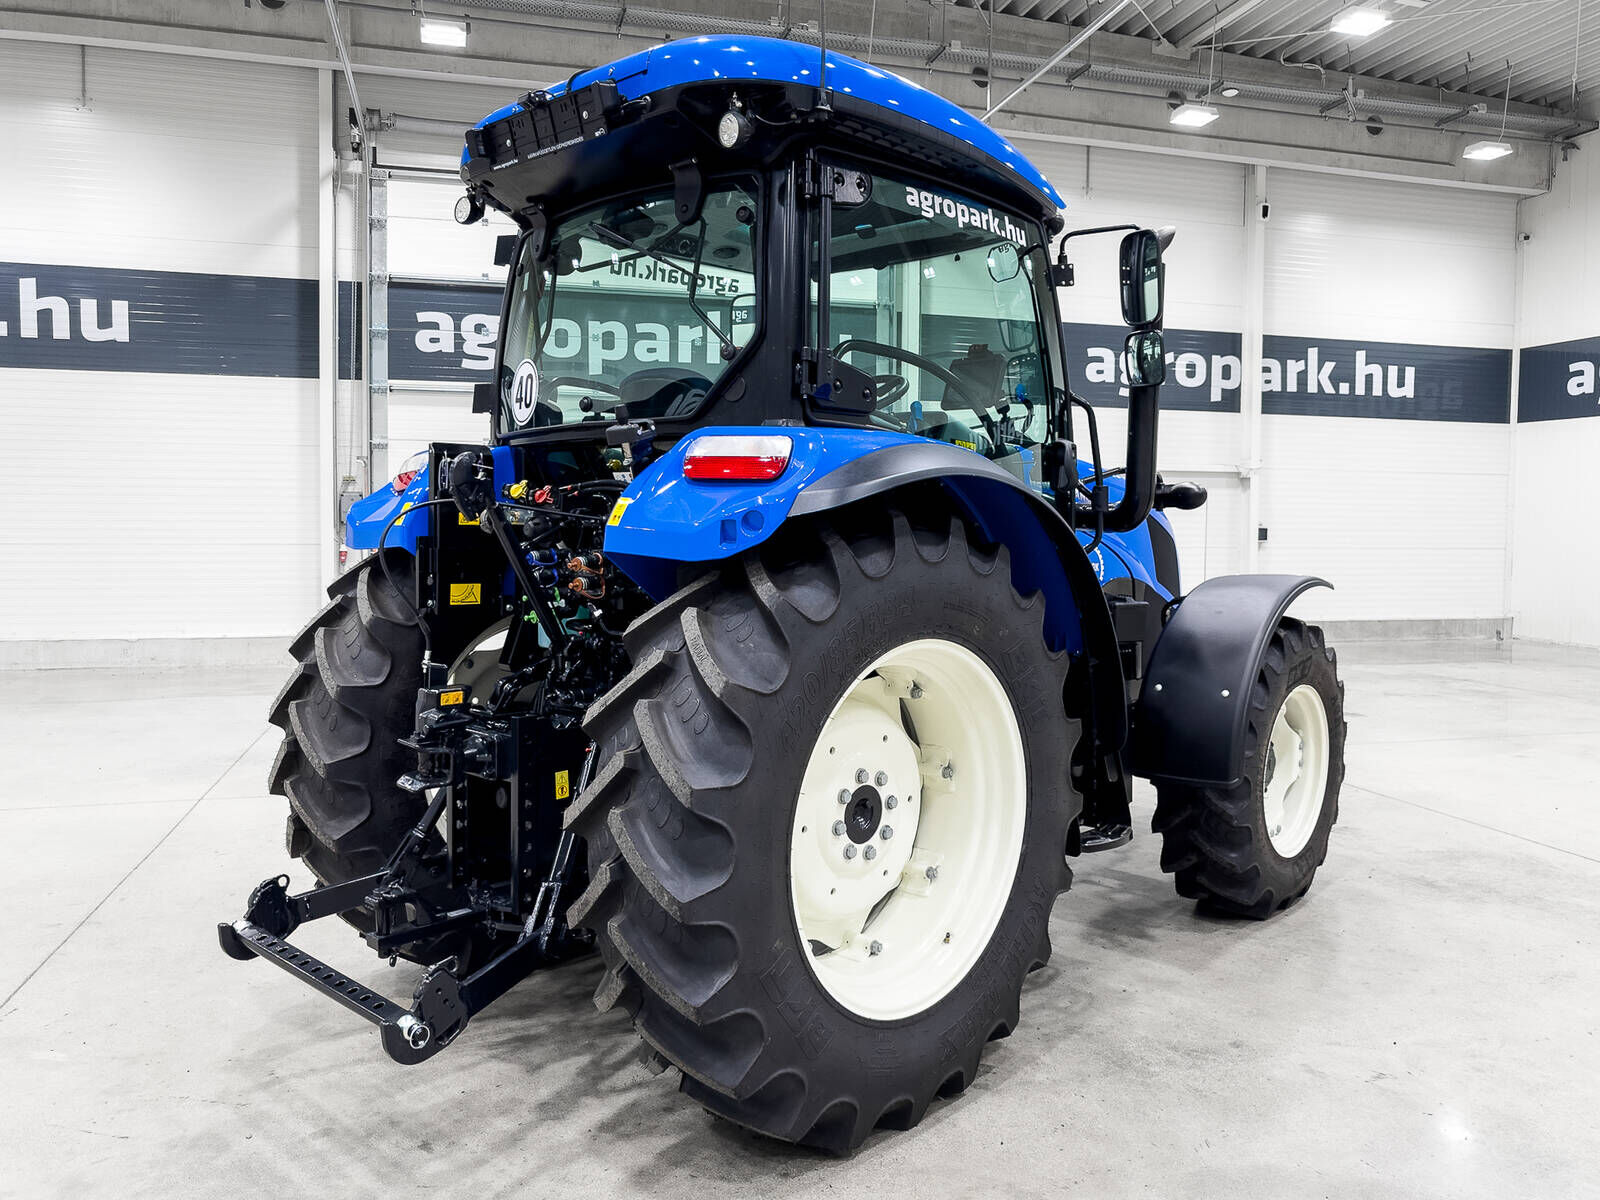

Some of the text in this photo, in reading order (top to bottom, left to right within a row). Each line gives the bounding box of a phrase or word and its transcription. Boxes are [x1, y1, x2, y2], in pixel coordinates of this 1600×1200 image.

[905, 185, 1027, 247] agropark.hu
[515, 373, 534, 410] 40
[1566, 360, 1600, 405] a
